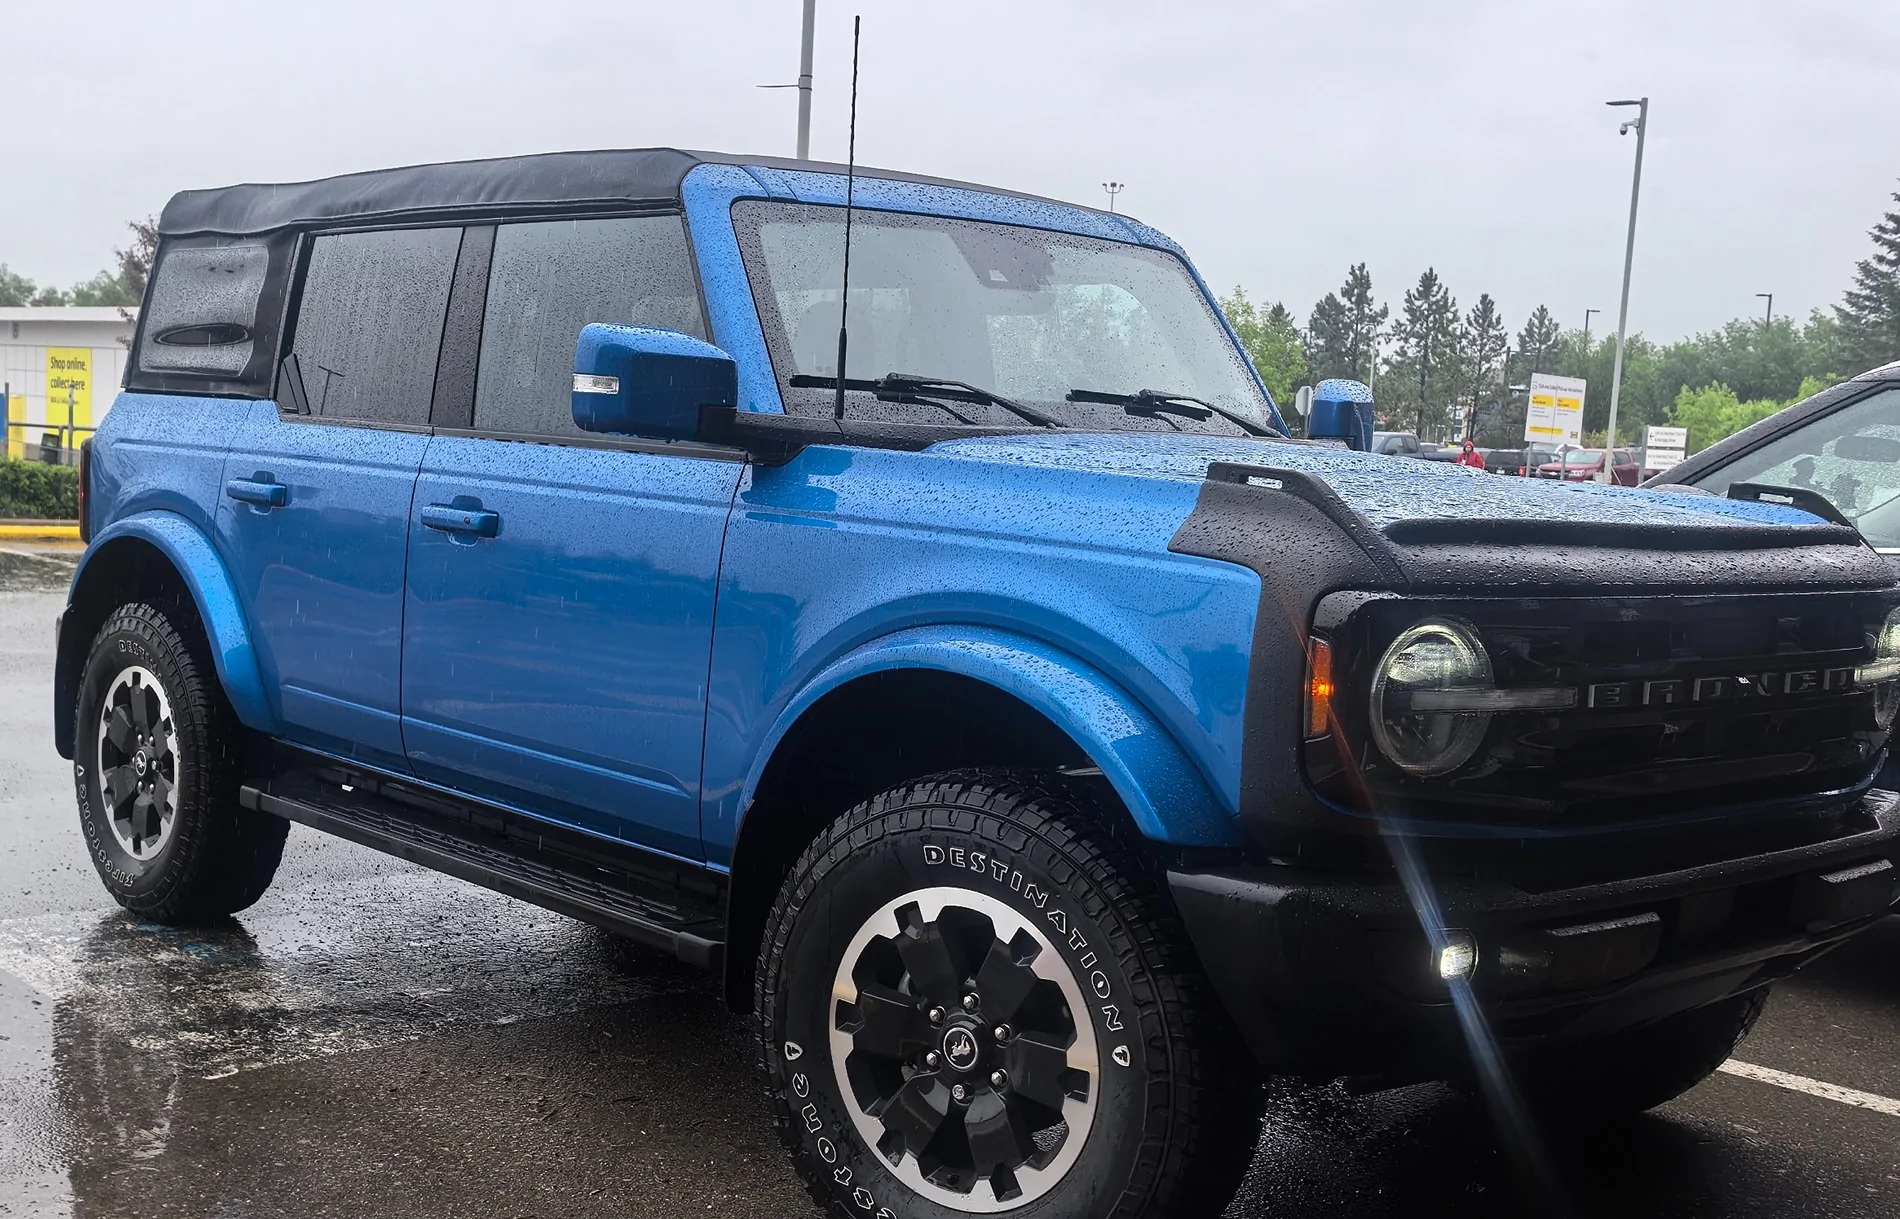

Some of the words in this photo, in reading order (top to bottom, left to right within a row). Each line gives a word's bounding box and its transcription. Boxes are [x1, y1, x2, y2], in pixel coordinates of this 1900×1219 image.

[51, 356, 66, 372] Shop
[66, 357, 87, 372] online,
[50, 376, 70, 389] collect
[1587, 666, 1857, 708] BRONCO
[923, 845, 1124, 1032] DESTINATION
